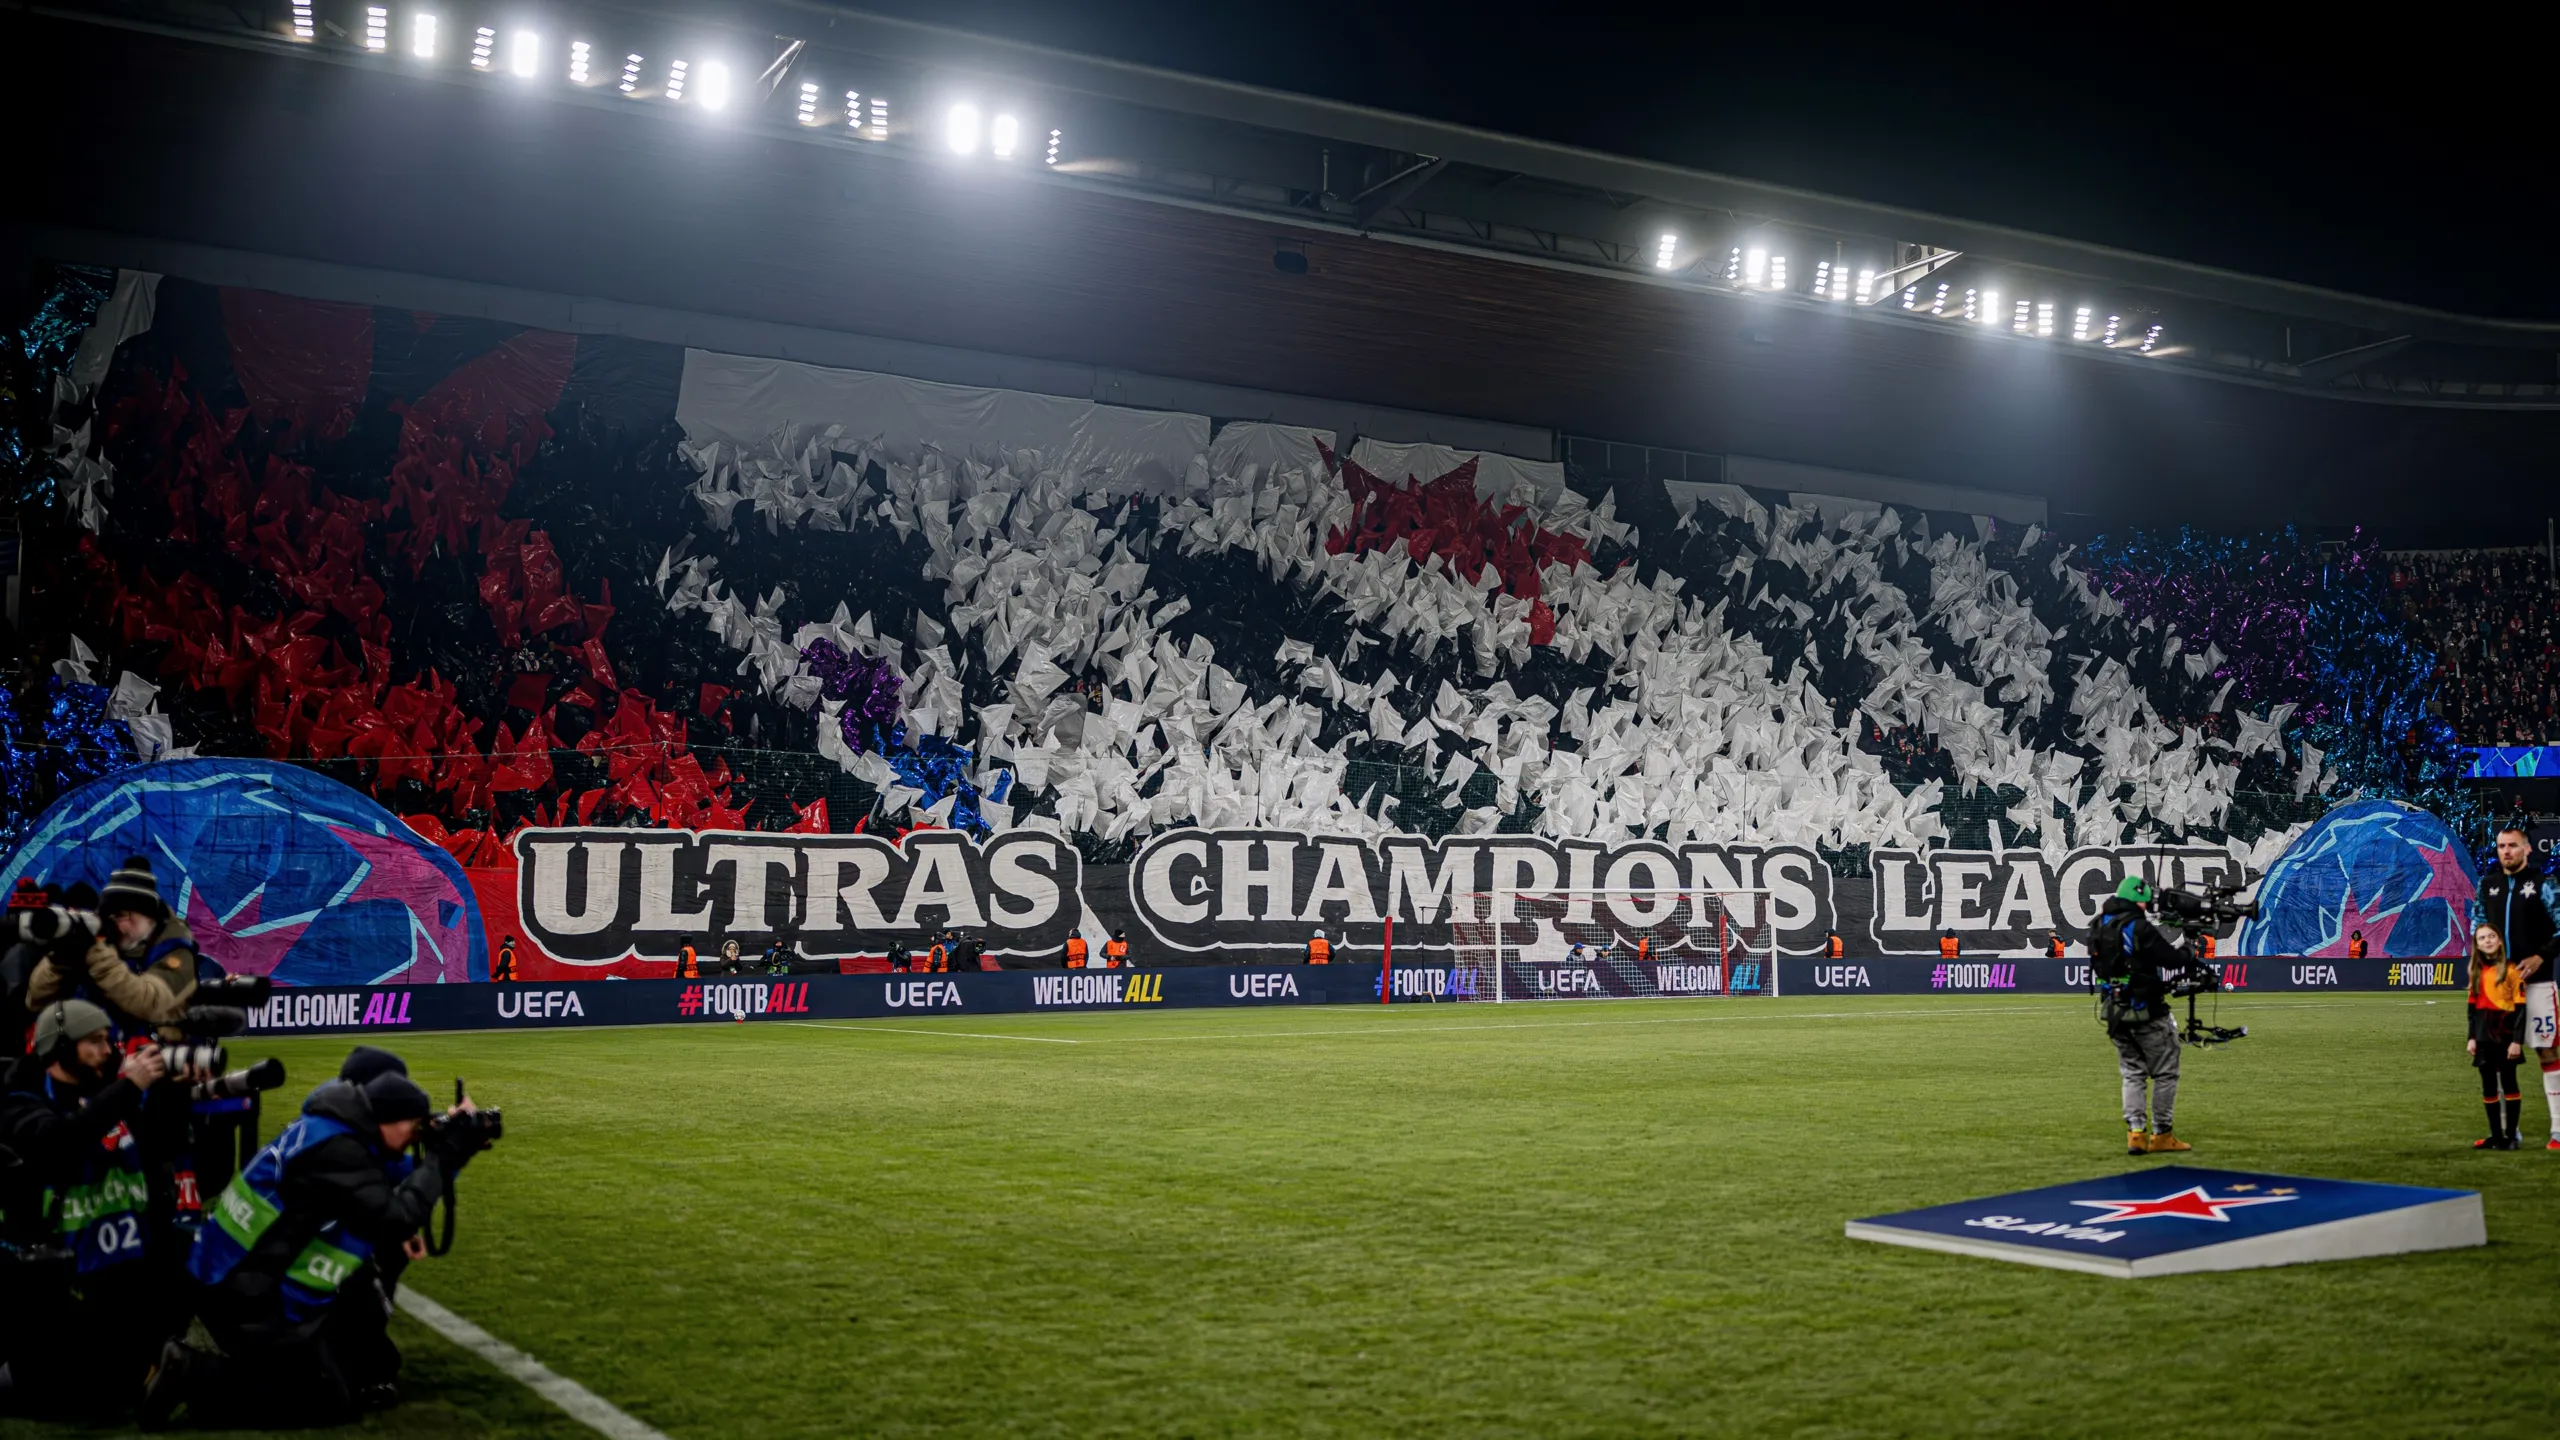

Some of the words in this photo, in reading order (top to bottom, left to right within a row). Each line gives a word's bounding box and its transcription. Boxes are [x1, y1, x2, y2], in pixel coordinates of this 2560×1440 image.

[530, 839, 1059, 935] ULTRAS
[1142, 838, 1818, 931] CHAMPIONS
[1230, 973, 1299, 998] UEFA
[1538, 969, 1600, 992] UEFA
[1656, 965, 1722, 991] WELCOM
[1729, 964, 1761, 990] ALL
[1814, 966, 1871, 988] UEFA
[1930, 963, 2016, 989] #FOOTBALL
[2221, 963, 2248, 987] ALL
[2291, 965, 2338, 985] UEFA
[2387, 963, 2455, 986] #FOOTBALL
[677, 982, 809, 1016] #FOOTBALL
[885, 981, 963, 1007] UEFA
[1033, 975, 1122, 1005] WELCOME
[1123, 974, 1164, 1002] ALL
[248, 993, 360, 1028] WELCOME
[361, 992, 412, 1025] ALL
[497, 990, 585, 1018] UEFA
[2533, 1016, 2555, 1033] 25
[97, 1215, 141, 1254] 02
[1964, 1215, 2127, 1243] SLAVIA
